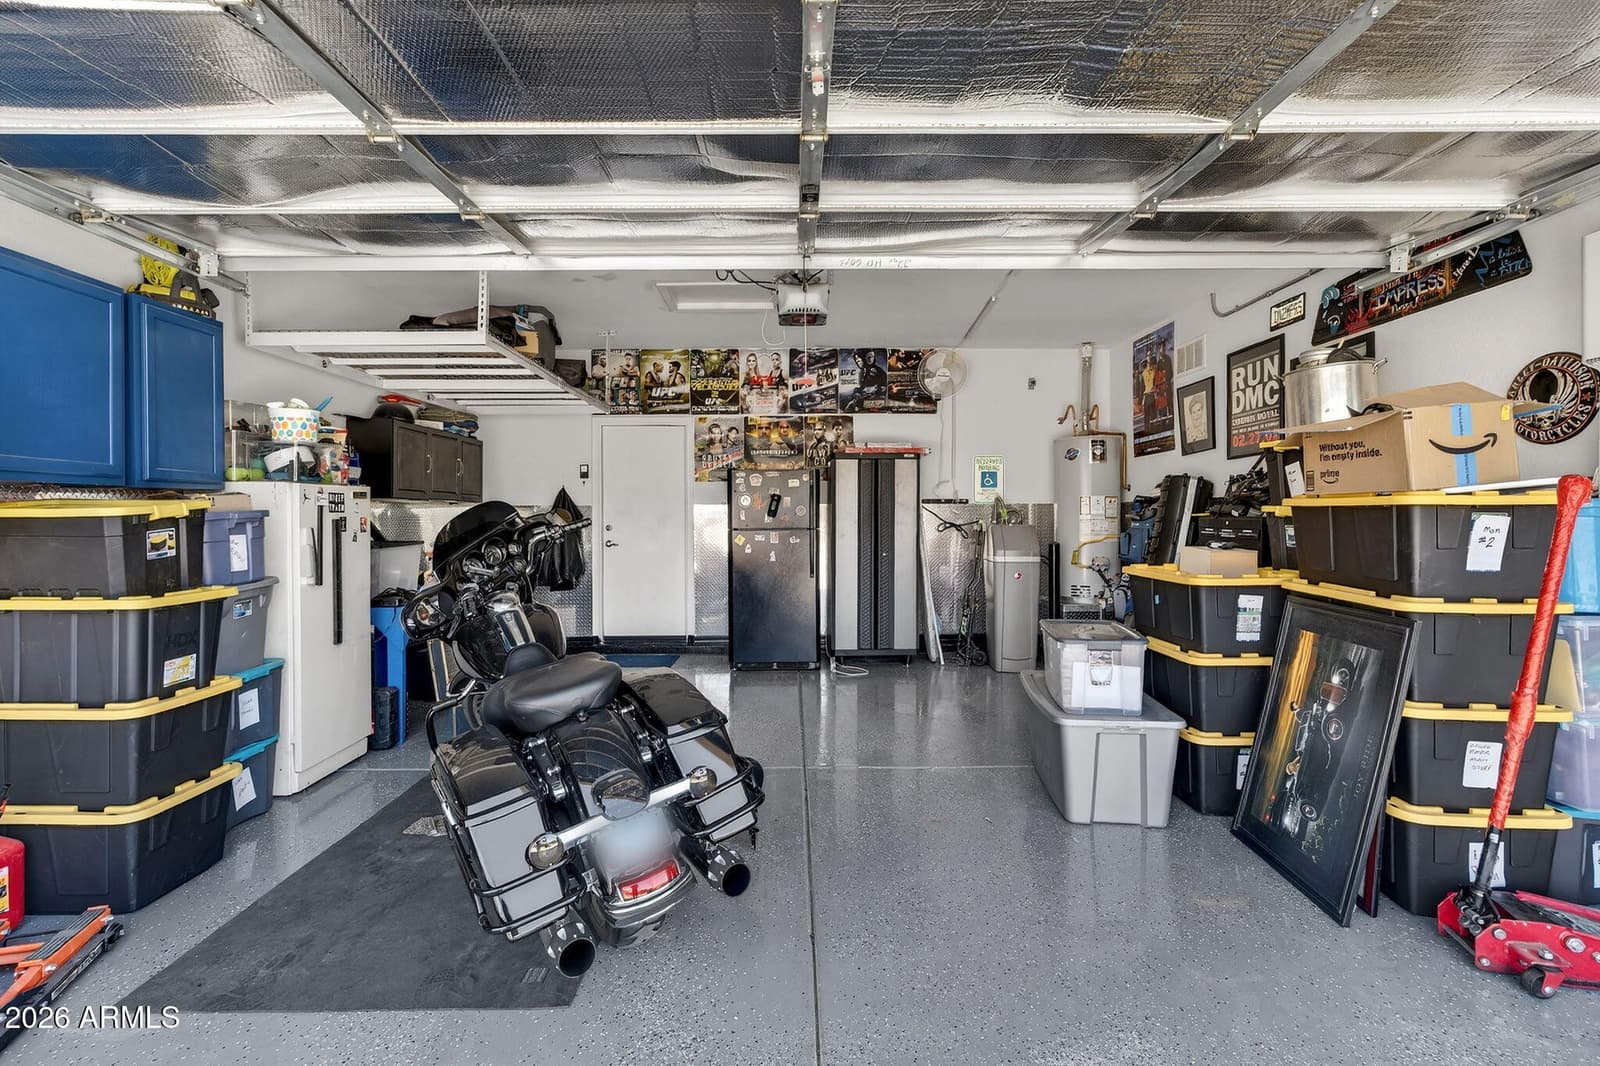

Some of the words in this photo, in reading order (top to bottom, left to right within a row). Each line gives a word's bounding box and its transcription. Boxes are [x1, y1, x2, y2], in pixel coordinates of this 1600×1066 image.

[1371, 274, 1446, 311] IMPRESS
[1231, 354, 1280, 392] RUN
[651, 387, 675, 397] UFC
[1231, 380, 1280, 415] DMC
[1319, 441, 1348, 452] Without
[1348, 441, 1366, 451] you,
[1319, 453, 1331, 462] I'm
[1331, 451, 1354, 461] empty
[1355, 448, 1383, 458] inside.
[1320, 469, 1340, 479] prime
